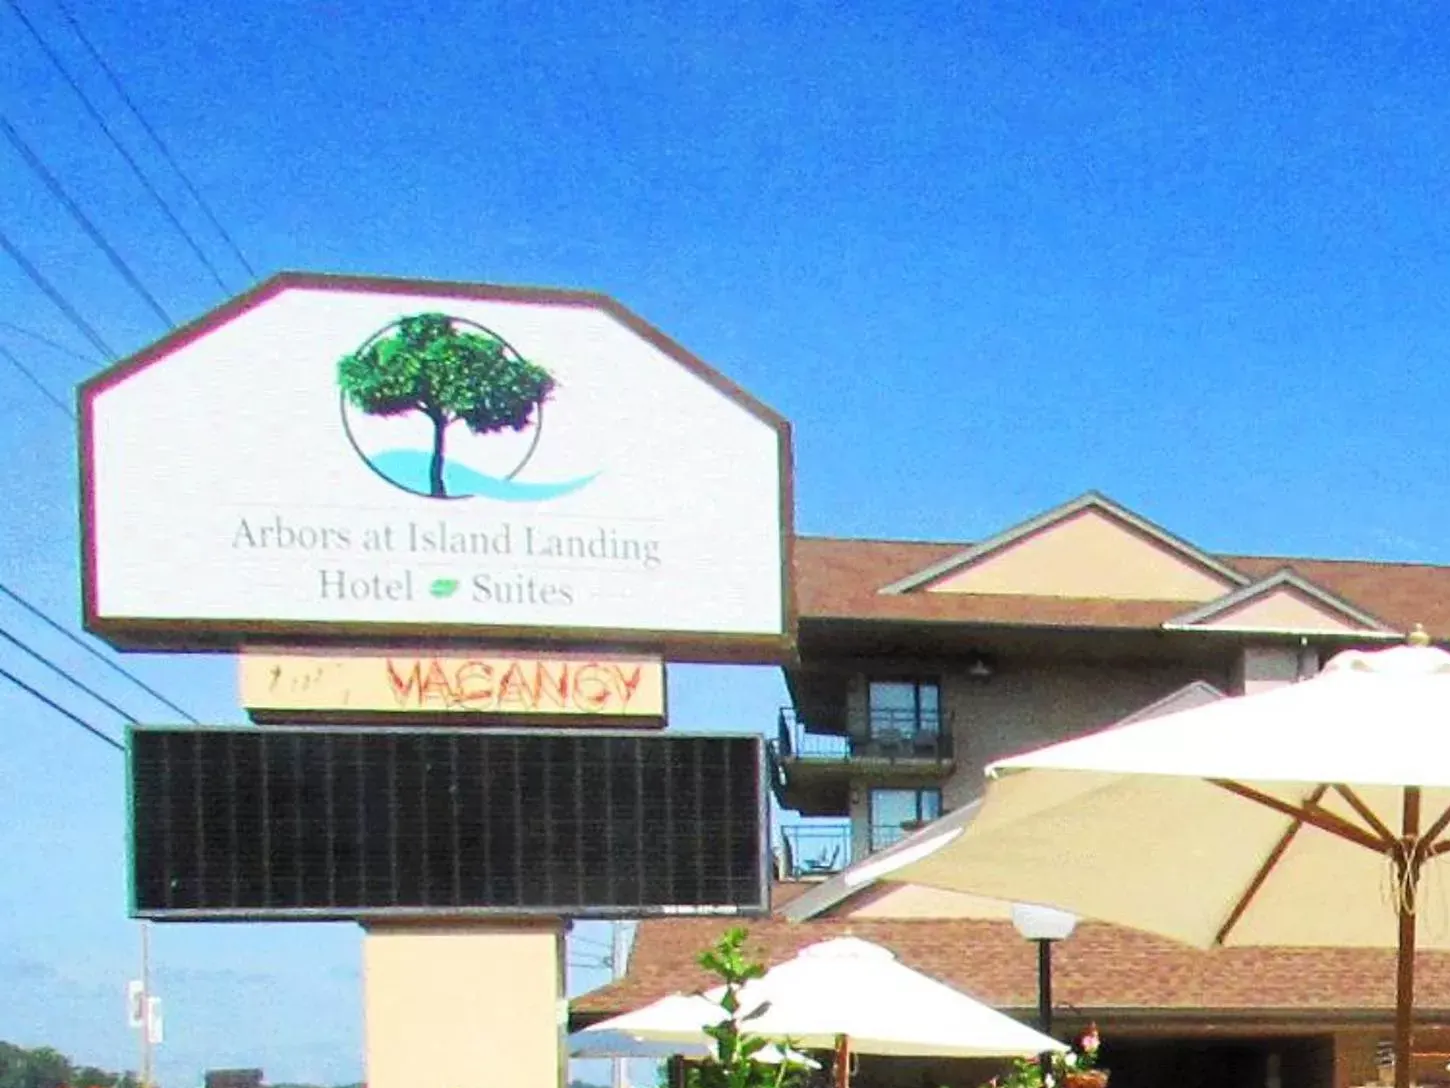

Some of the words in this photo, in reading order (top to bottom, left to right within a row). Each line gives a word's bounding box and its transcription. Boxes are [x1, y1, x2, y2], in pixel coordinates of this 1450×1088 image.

[232, 517, 352, 550] Arbors
[363, 526, 394, 552] at
[409, 522, 513, 555] Island
[525, 527, 663, 567] Landing
[319, 570, 415, 601] Hotel
[472, 574, 575, 606] Suites
[385, 657, 642, 713] VACANCY
